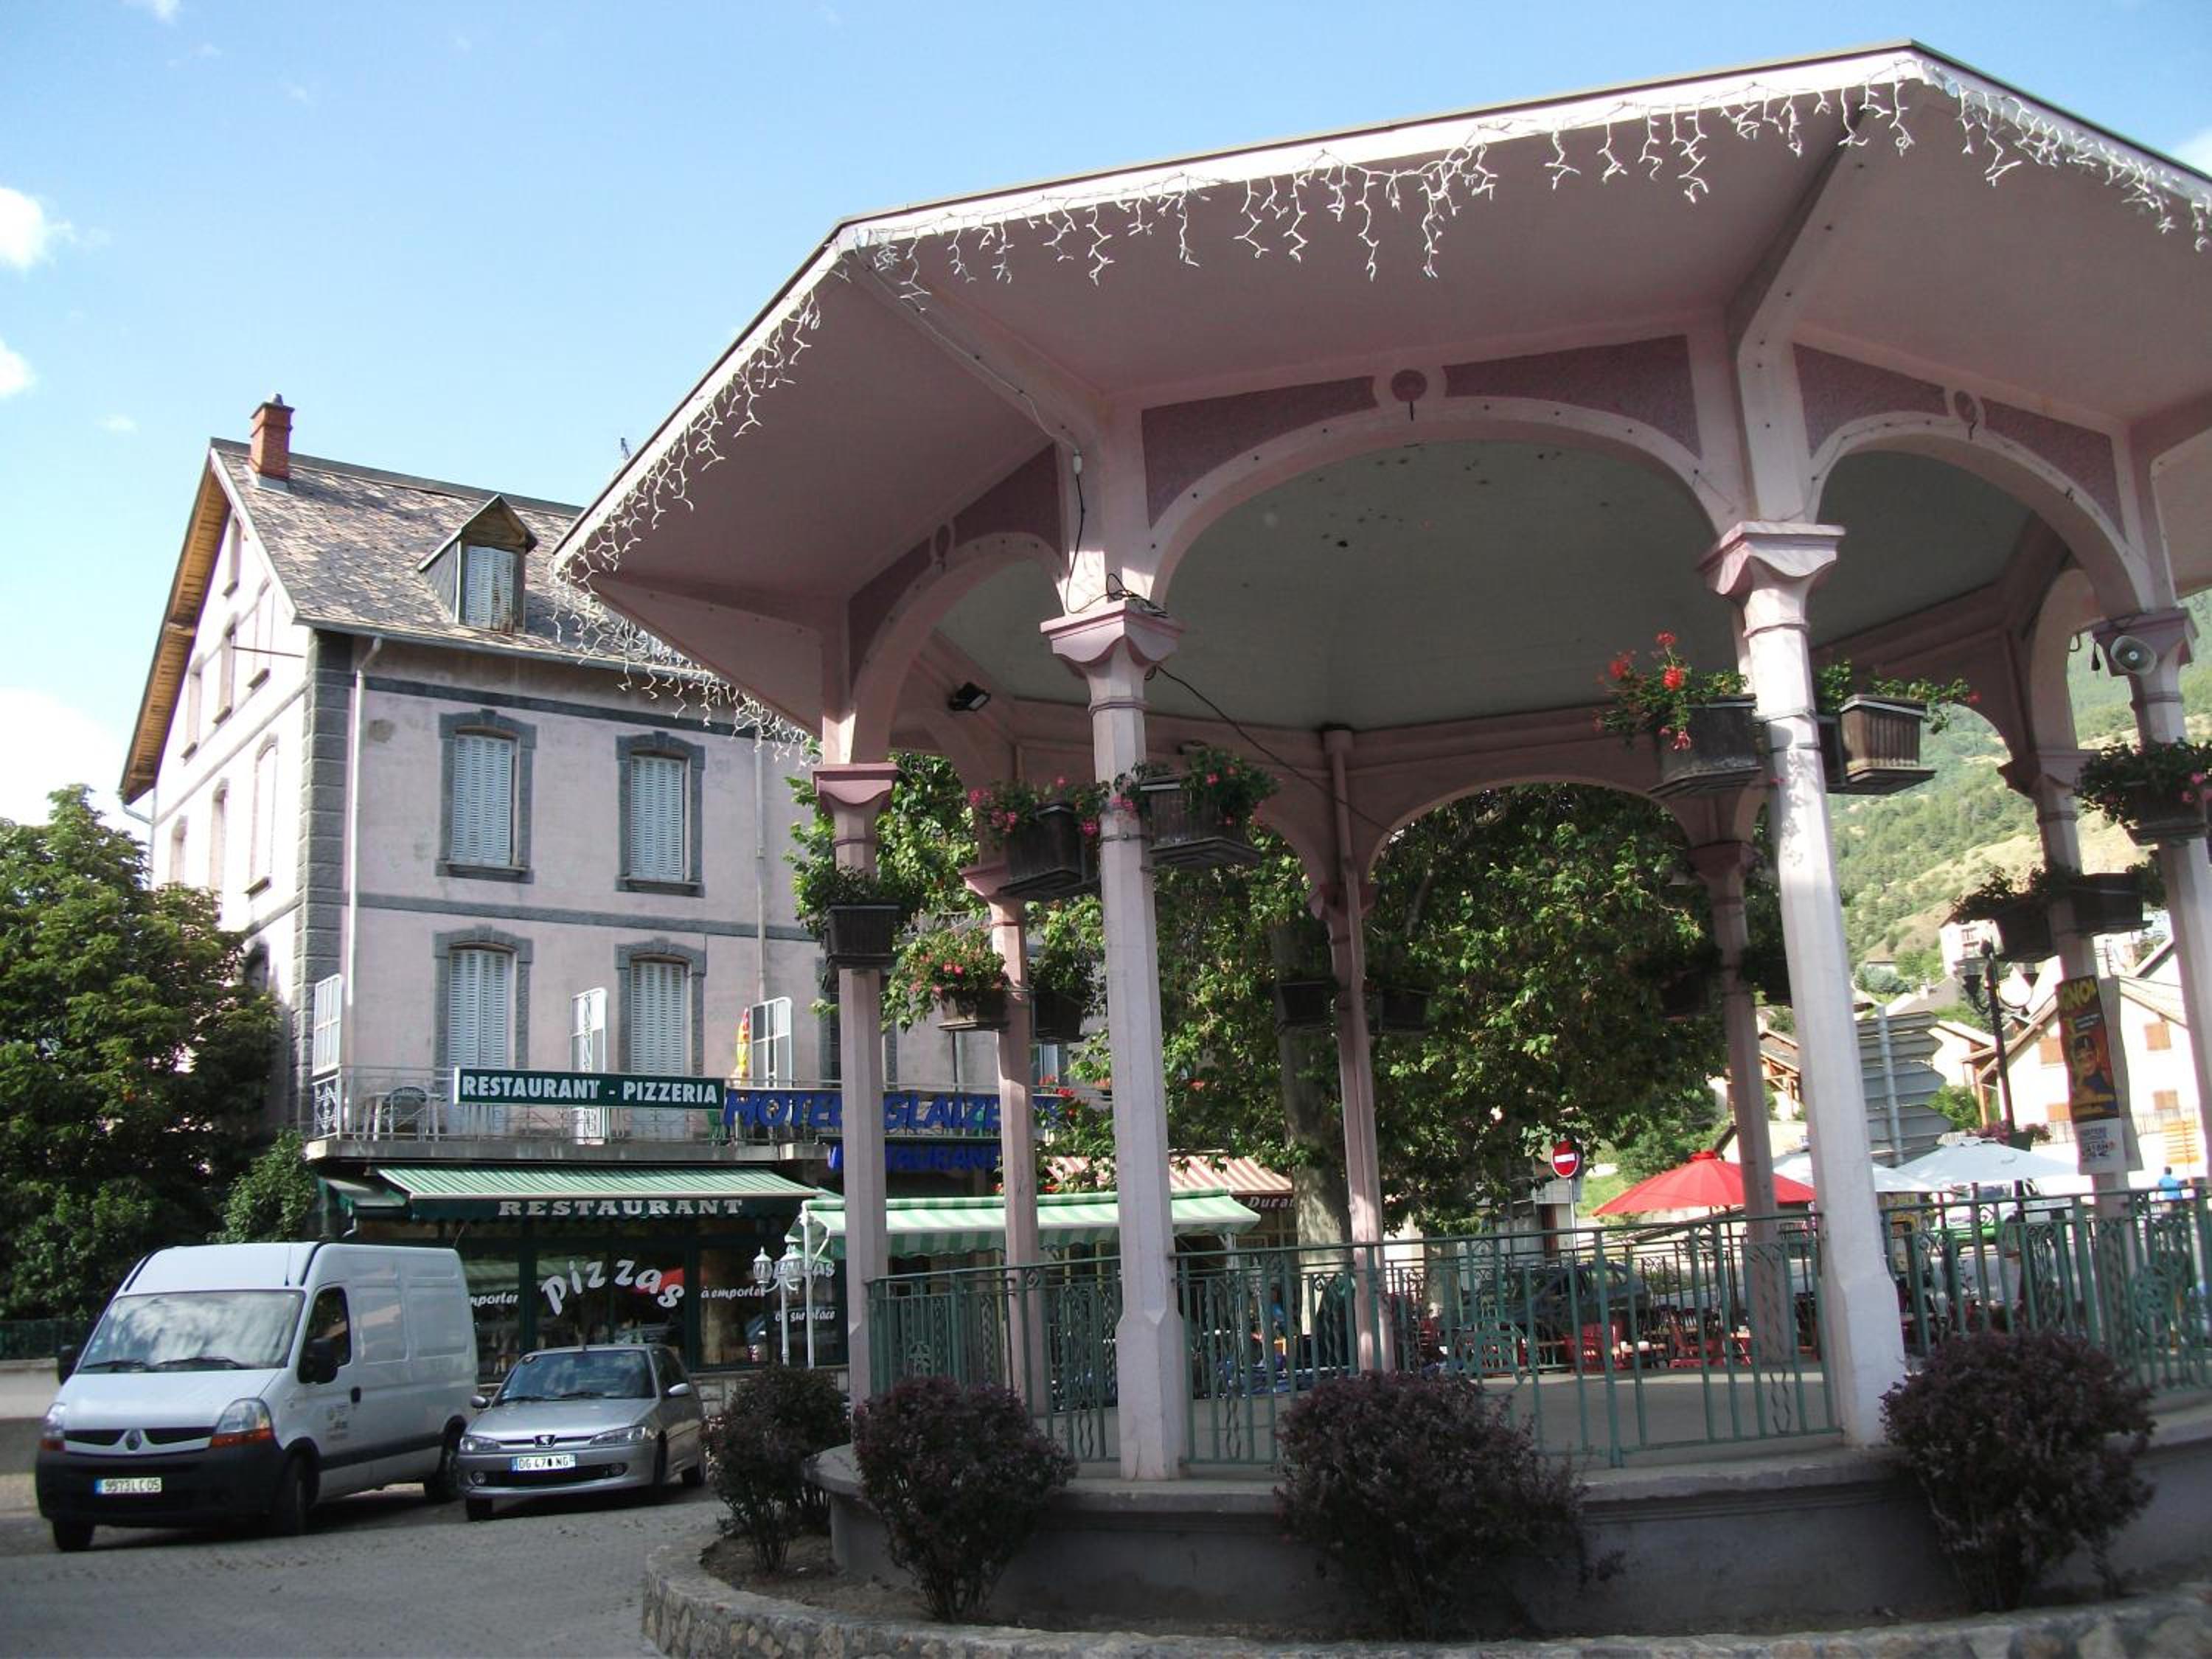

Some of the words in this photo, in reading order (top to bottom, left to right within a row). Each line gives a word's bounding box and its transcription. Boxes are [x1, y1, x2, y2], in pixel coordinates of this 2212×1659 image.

[462, 1076, 601, 1099] RESTAURANT
[622, 1080, 717, 1104] PIZZERIA
[498, 1200, 742, 1215] RESTAURANT
[470, 1284, 519, 1308] mporter
[540, 1259, 684, 1315] pizzas
[701, 1287, 709, 1298] à
[811, 1309, 835, 1321] lace
